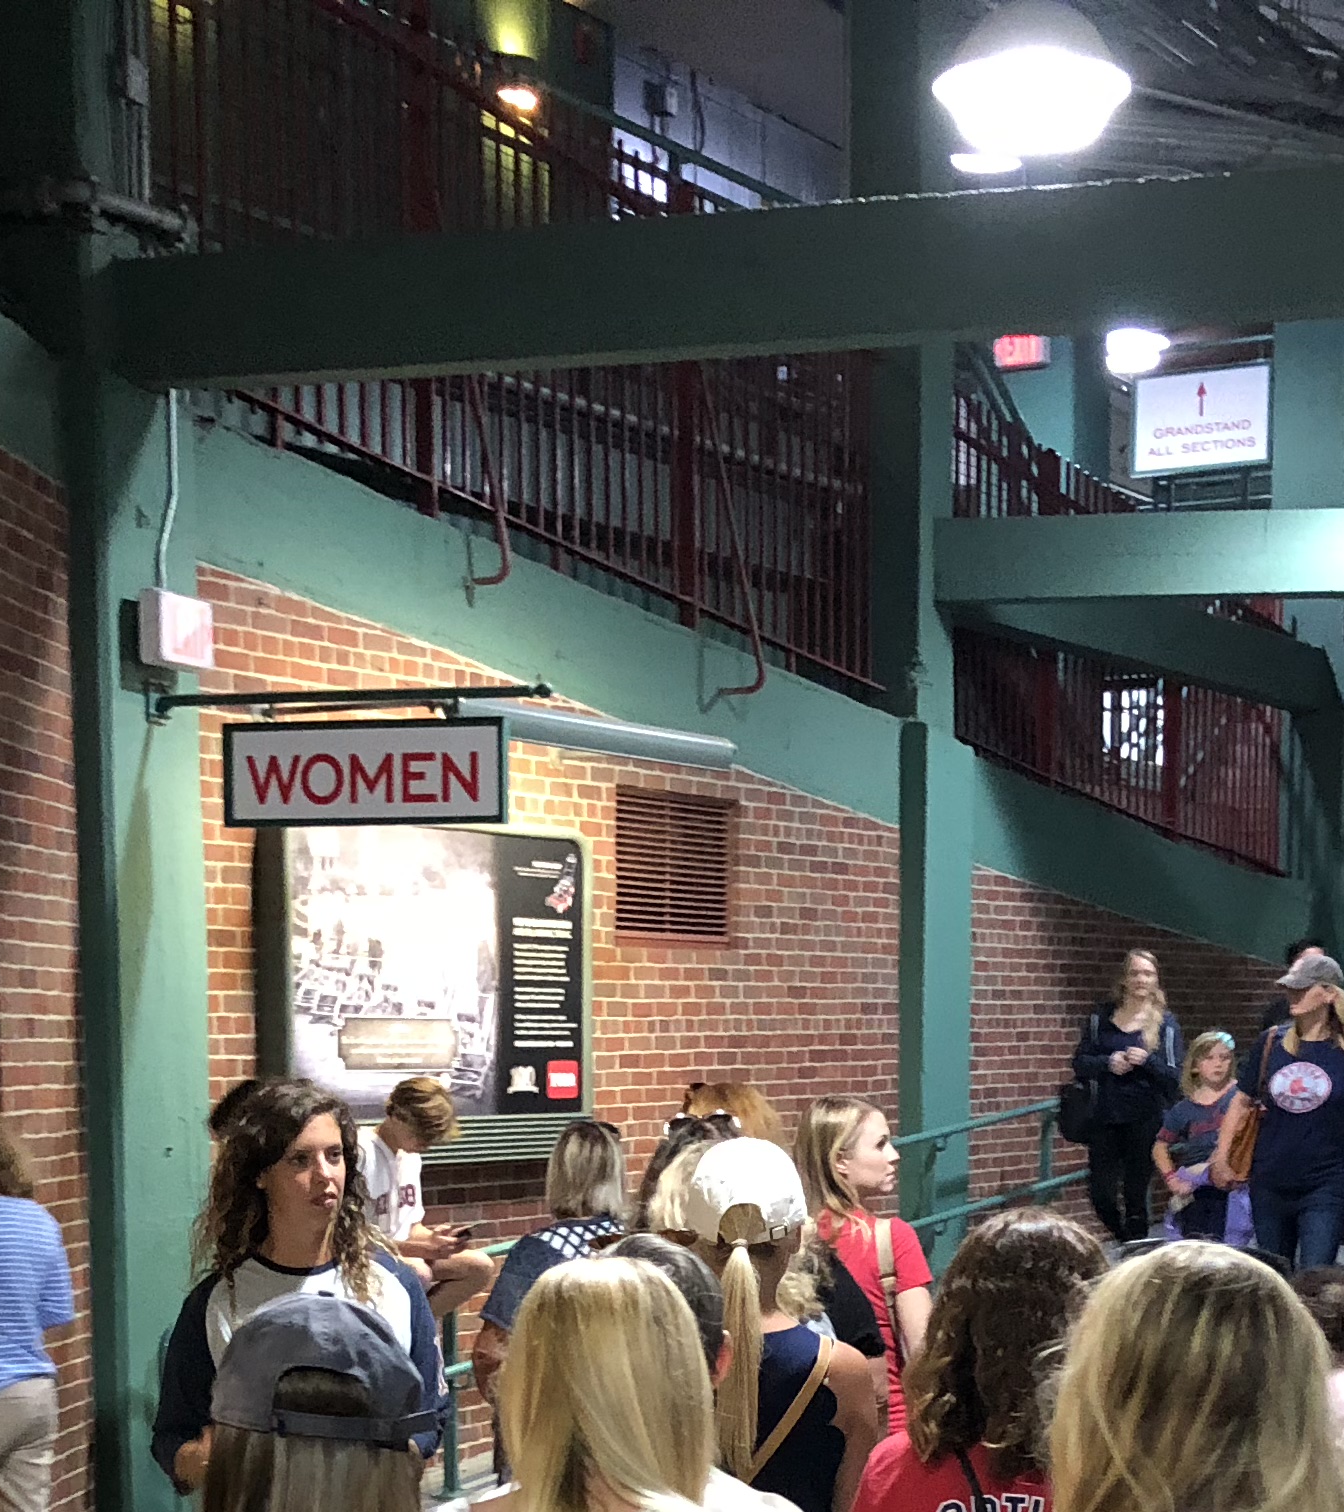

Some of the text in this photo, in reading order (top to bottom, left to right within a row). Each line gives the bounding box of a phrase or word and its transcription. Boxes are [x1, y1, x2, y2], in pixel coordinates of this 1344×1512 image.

[1153, 419, 1252, 440] GRANDSTAND
[1147, 436, 1257, 457] ALL SECTIONS
[246, 751, 481, 806] WOMEN
